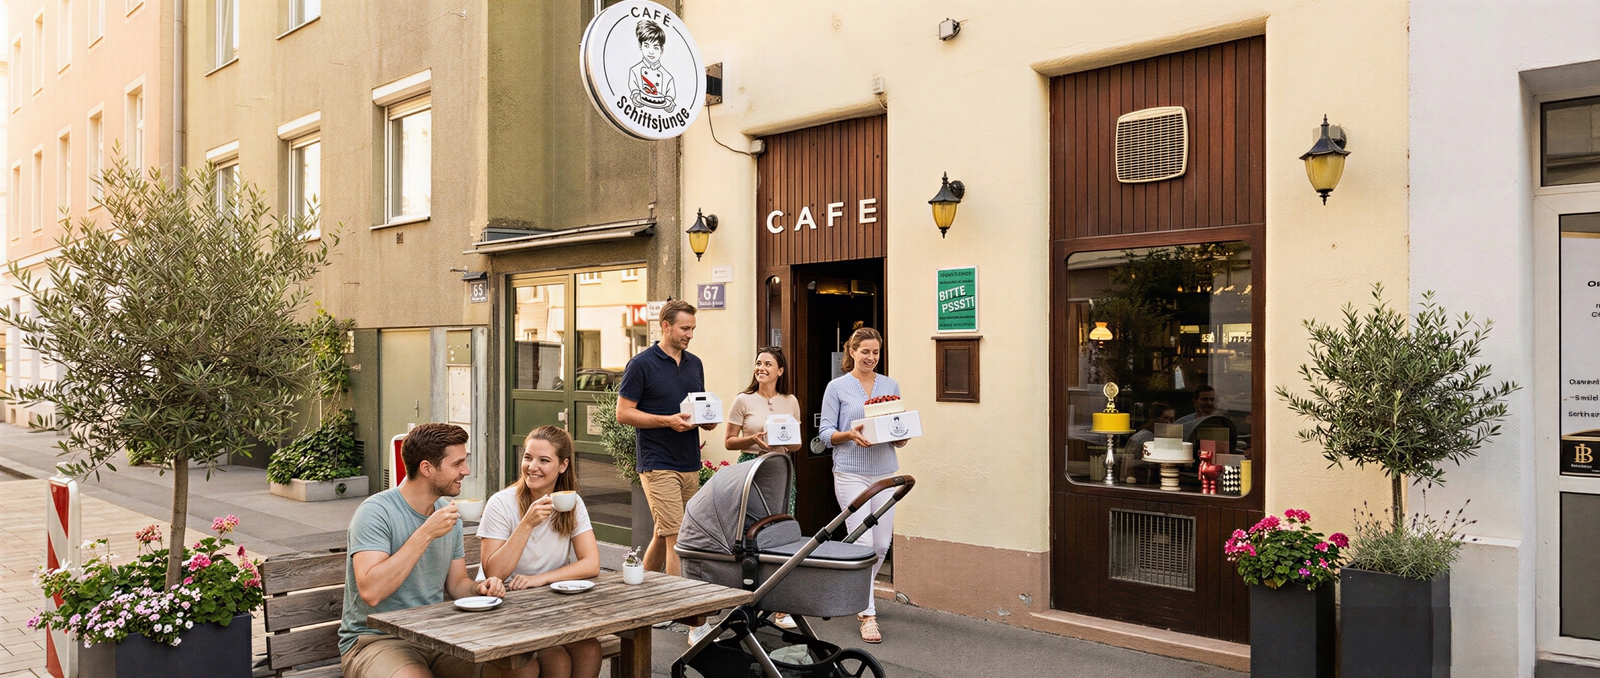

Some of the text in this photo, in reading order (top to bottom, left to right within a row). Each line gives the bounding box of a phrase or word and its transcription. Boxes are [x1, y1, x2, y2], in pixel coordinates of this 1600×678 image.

[630, 6, 672, 28] CAFÉ
[766, 198, 877, 234] CAFE
[474, 284, 483, 297] 65
[703, 285, 719, 300] 67
[939, 285, 966, 301] BITTE
